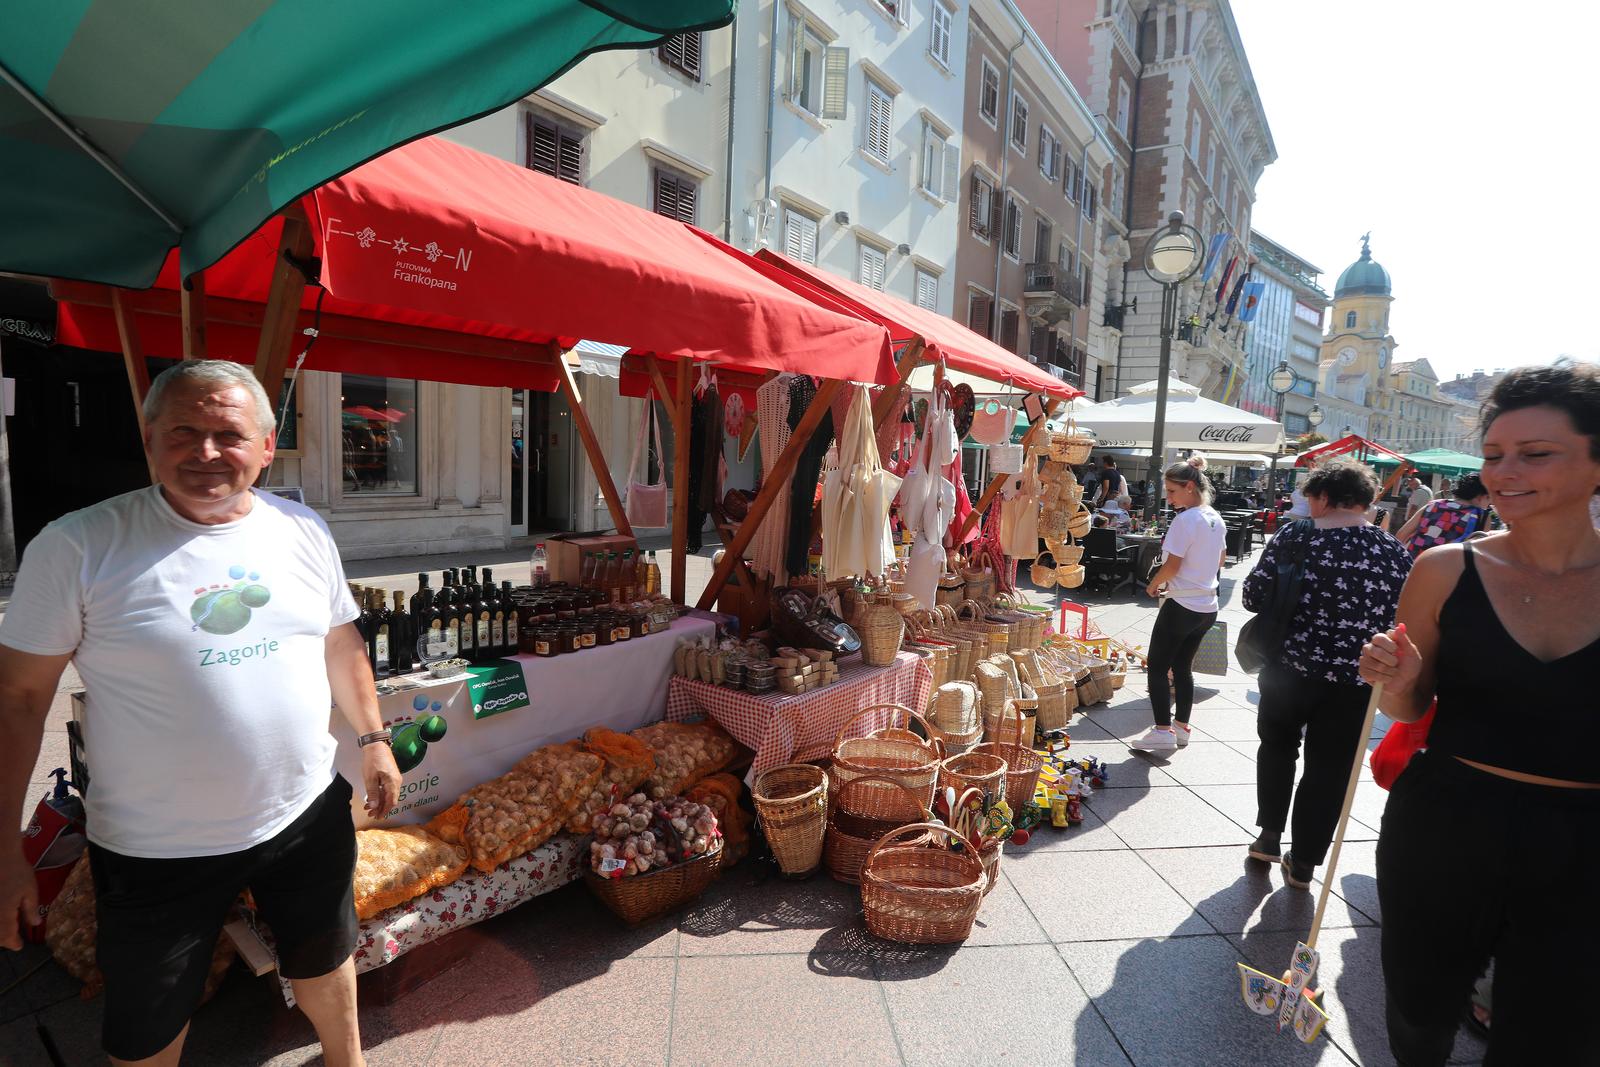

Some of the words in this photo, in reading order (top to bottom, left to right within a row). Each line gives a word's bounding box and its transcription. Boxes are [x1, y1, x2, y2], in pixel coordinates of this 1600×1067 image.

[395, 260, 432, 274] PUTOVIMA
[393, 269, 457, 291] Frankopana
[1199, 425, 1256, 442] Coca-Cola
[198, 637, 279, 667] Zagorje
[397, 773, 440, 802] gorje
[401, 803, 412, 813] na
[413, 794, 439, 809] dlanu
